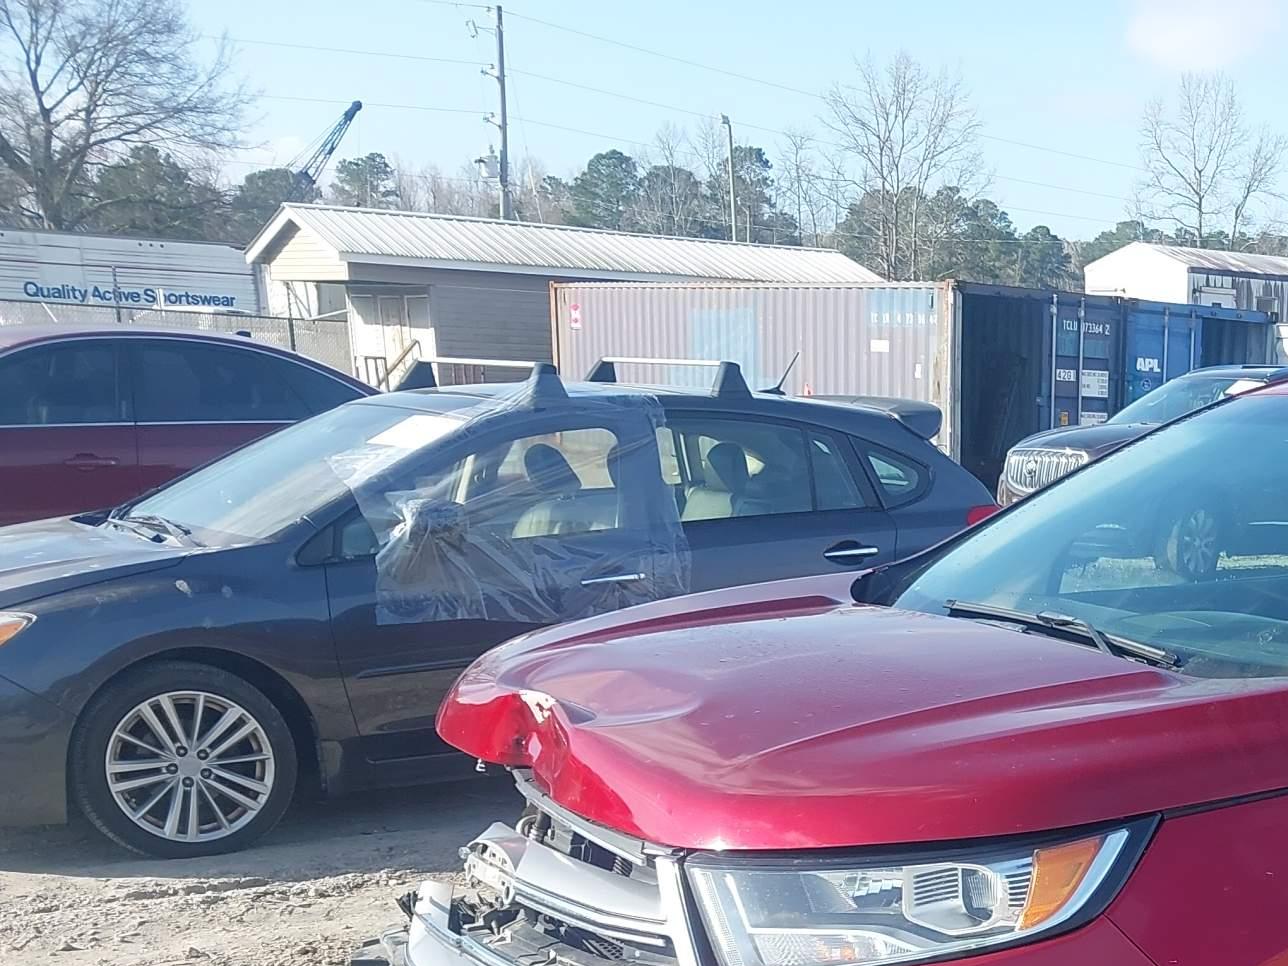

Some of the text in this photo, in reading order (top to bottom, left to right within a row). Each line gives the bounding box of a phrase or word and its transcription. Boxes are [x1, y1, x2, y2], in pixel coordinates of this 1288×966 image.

[23, 281, 88, 304] Quality
[91, 285, 141, 303] Active
[1136, 357, 1161, 373] APL
